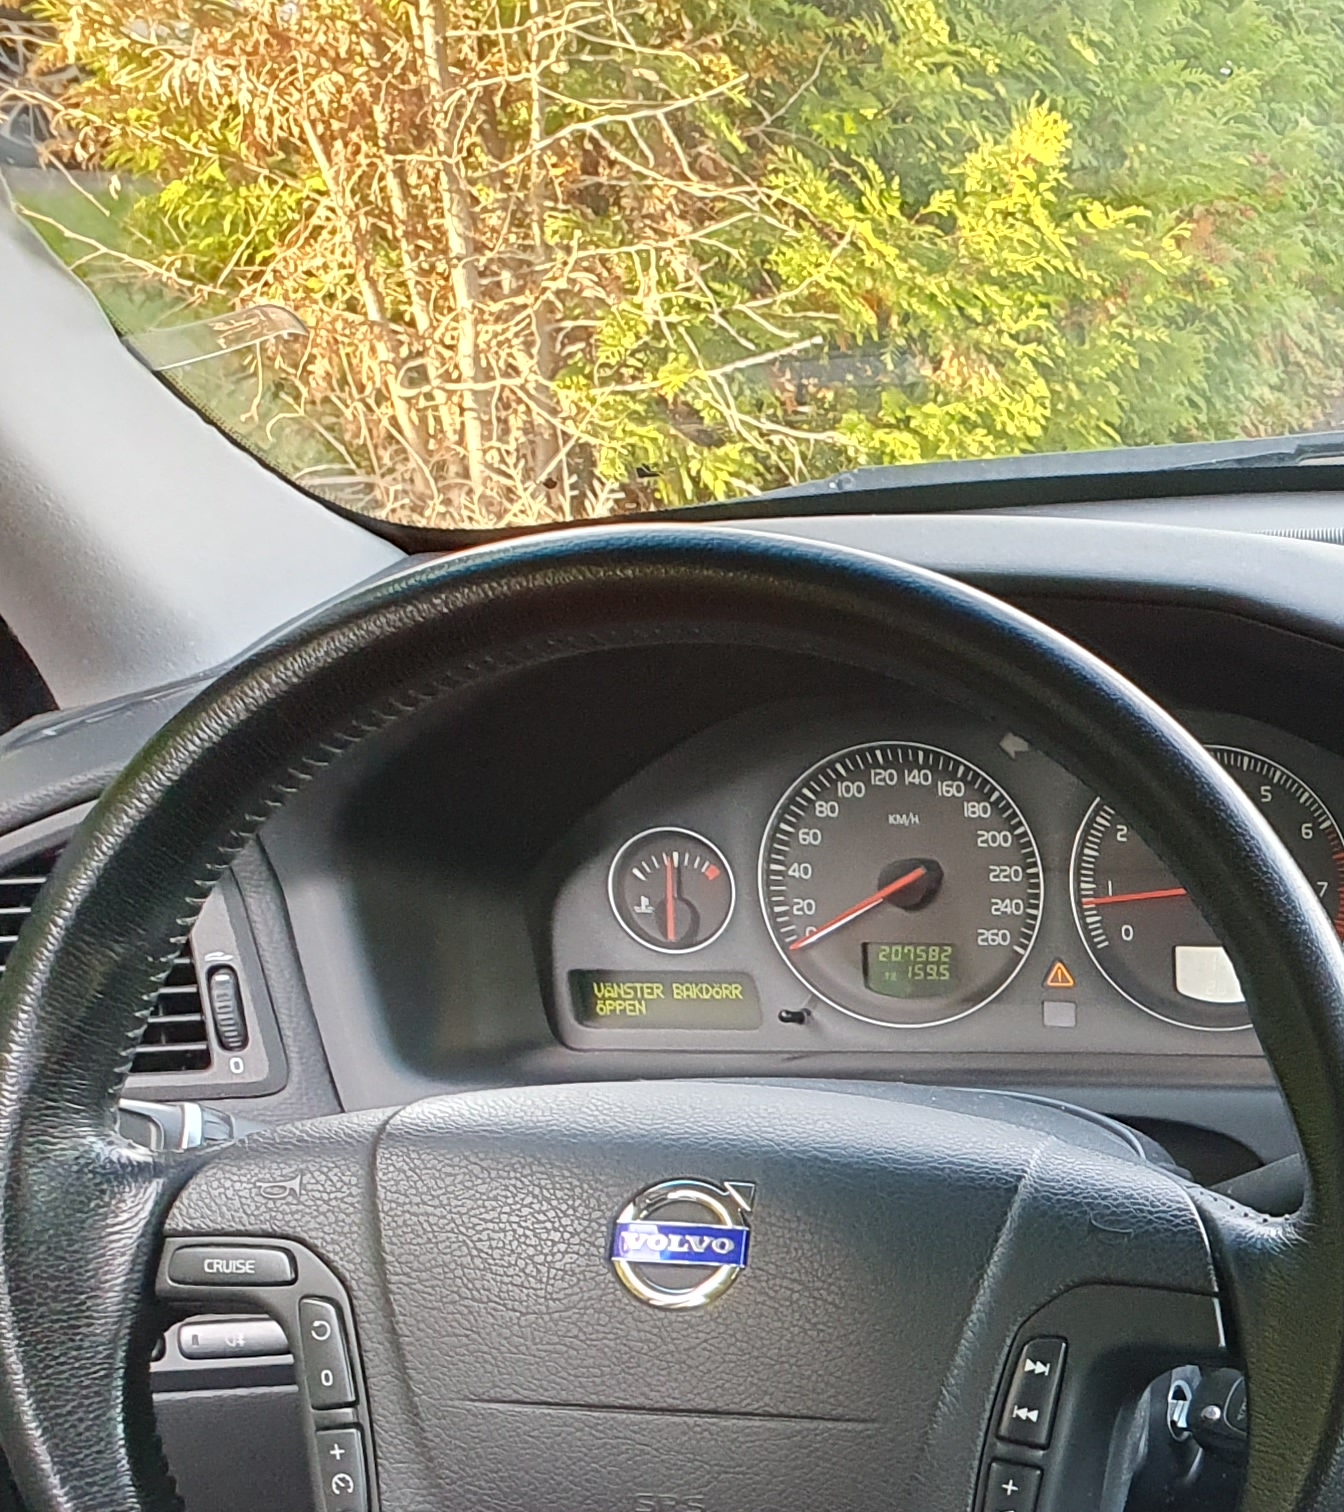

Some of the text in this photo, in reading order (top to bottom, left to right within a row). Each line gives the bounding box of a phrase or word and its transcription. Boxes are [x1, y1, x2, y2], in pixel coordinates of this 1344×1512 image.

[871, 769, 897, 785] 120
[904, 769, 932, 785] 140
[837, 781, 865, 797] 100
[938, 781, 965, 797] 160
[1260, 786, 1272, 802] 5
[815, 801, 839, 817] 80
[963, 801, 991, 818] 180
[888, 813, 920, 826] KM/H
[798, 829, 821, 845] 60
[977, 831, 1012, 847] 200
[1116, 825, 1128, 841] 2
[1301, 823, 1313, 839] 6
[788, 863, 812, 879] 40
[989, 865, 1023, 882] 220
[792, 899, 816, 915] 20
[991, 899, 1024, 915] 240
[977, 929, 1011, 945] 260
[1121, 925, 1134, 941] 0
[621, 1231, 735, 1255] VOLVO
[203, 1259, 256, 1274] CRUISE
